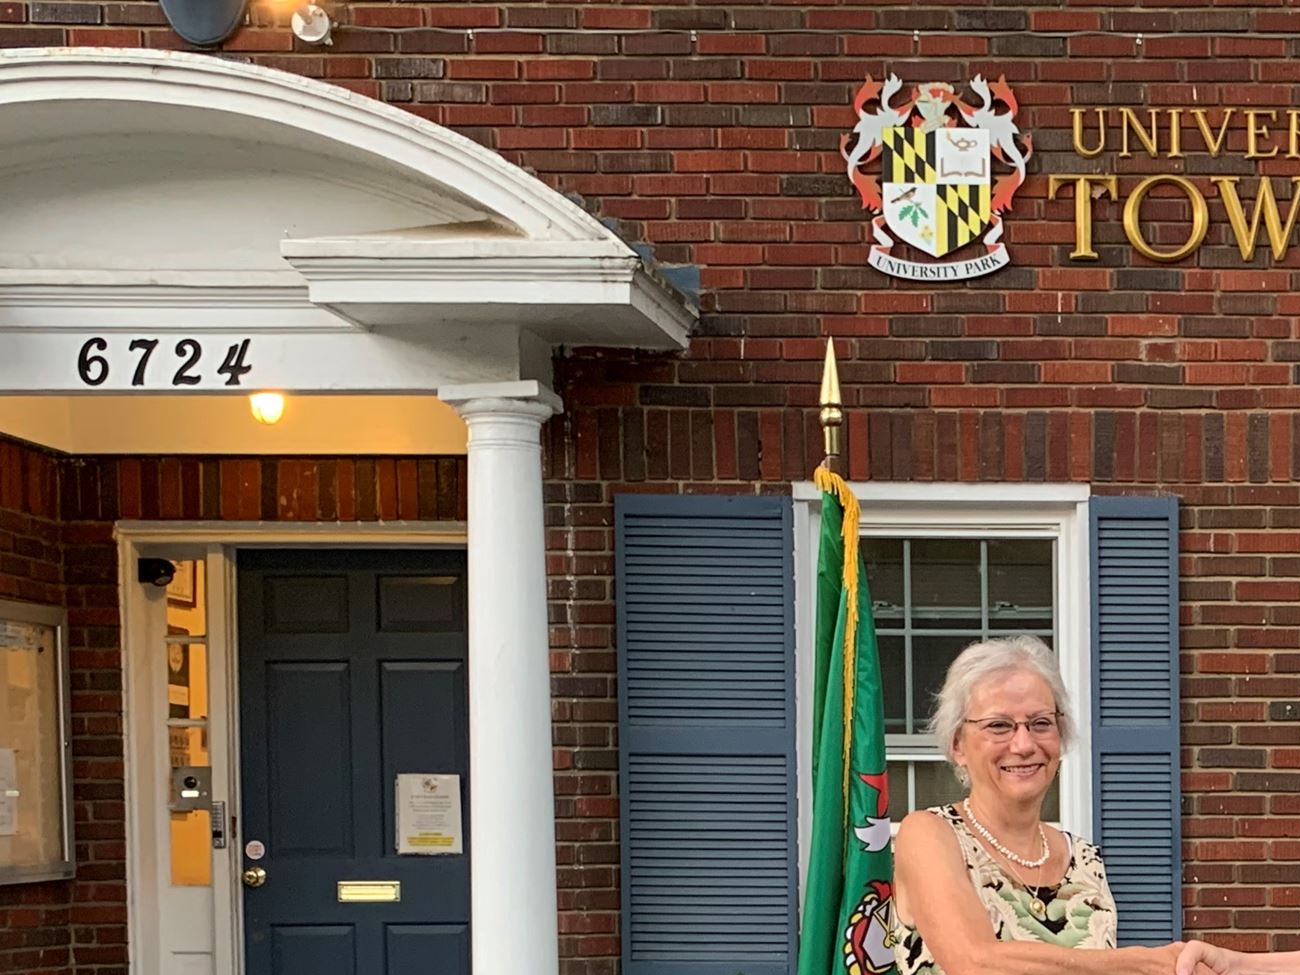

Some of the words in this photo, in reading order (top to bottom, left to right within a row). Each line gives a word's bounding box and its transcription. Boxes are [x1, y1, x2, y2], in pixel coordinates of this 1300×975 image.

[876, 255, 961, 279] UNIVERSITY
[964, 252, 1001, 275] PARK
[77, 336, 252, 387] 6724
